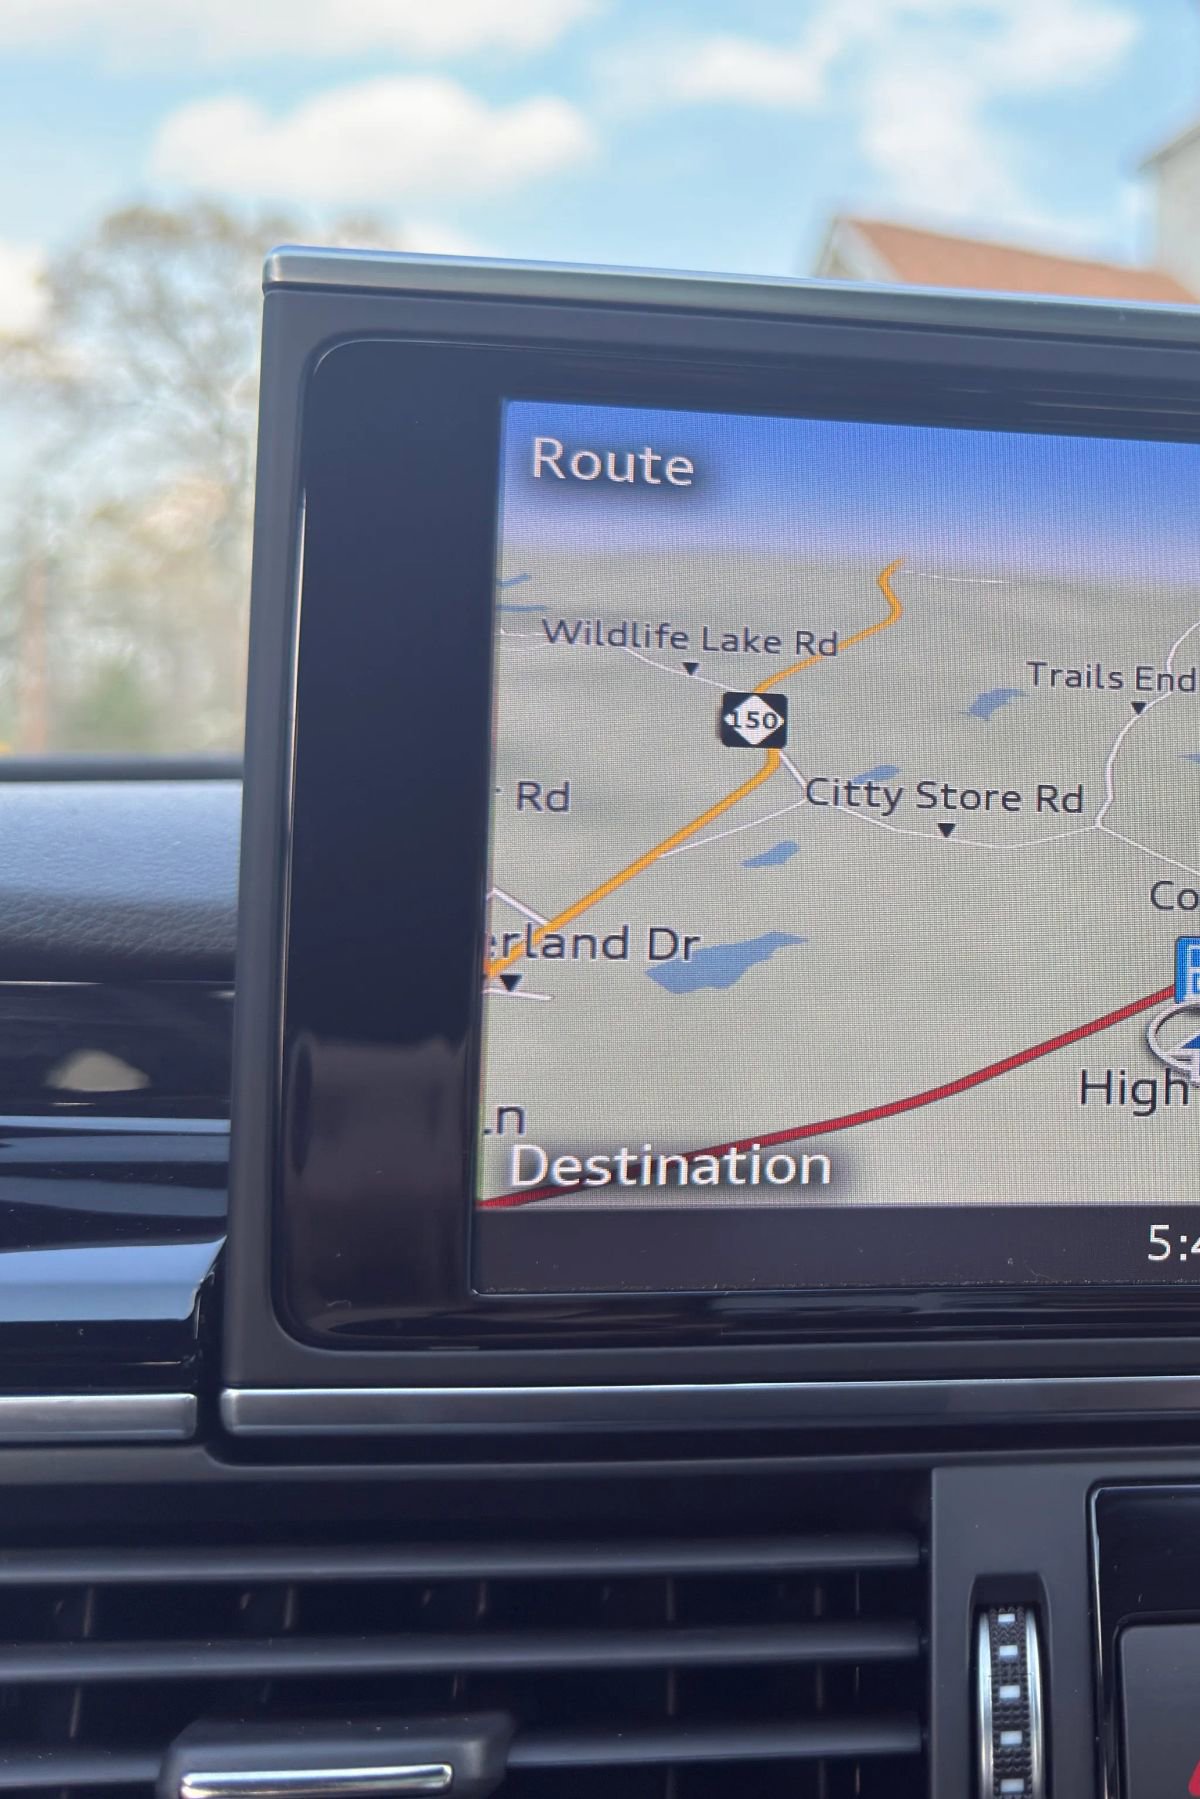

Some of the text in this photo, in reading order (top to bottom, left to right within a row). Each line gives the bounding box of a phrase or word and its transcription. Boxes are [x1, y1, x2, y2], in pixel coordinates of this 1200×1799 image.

[533, 436, 695, 487] Route
[542, 618, 839, 657] Wildlife Lake Rd
[1028, 661, 1124, 691] Trails
[1135, 666, 1196, 693] End
[730, 710, 779, 731] 150
[517, 780, 570, 812] Rd
[806, 777, 1084, 817] Citty Store Rd
[649, 926, 702, 962] Dr
[1080, 1067, 1189, 1118] High
[511, 1143, 832, 1187] Destination
